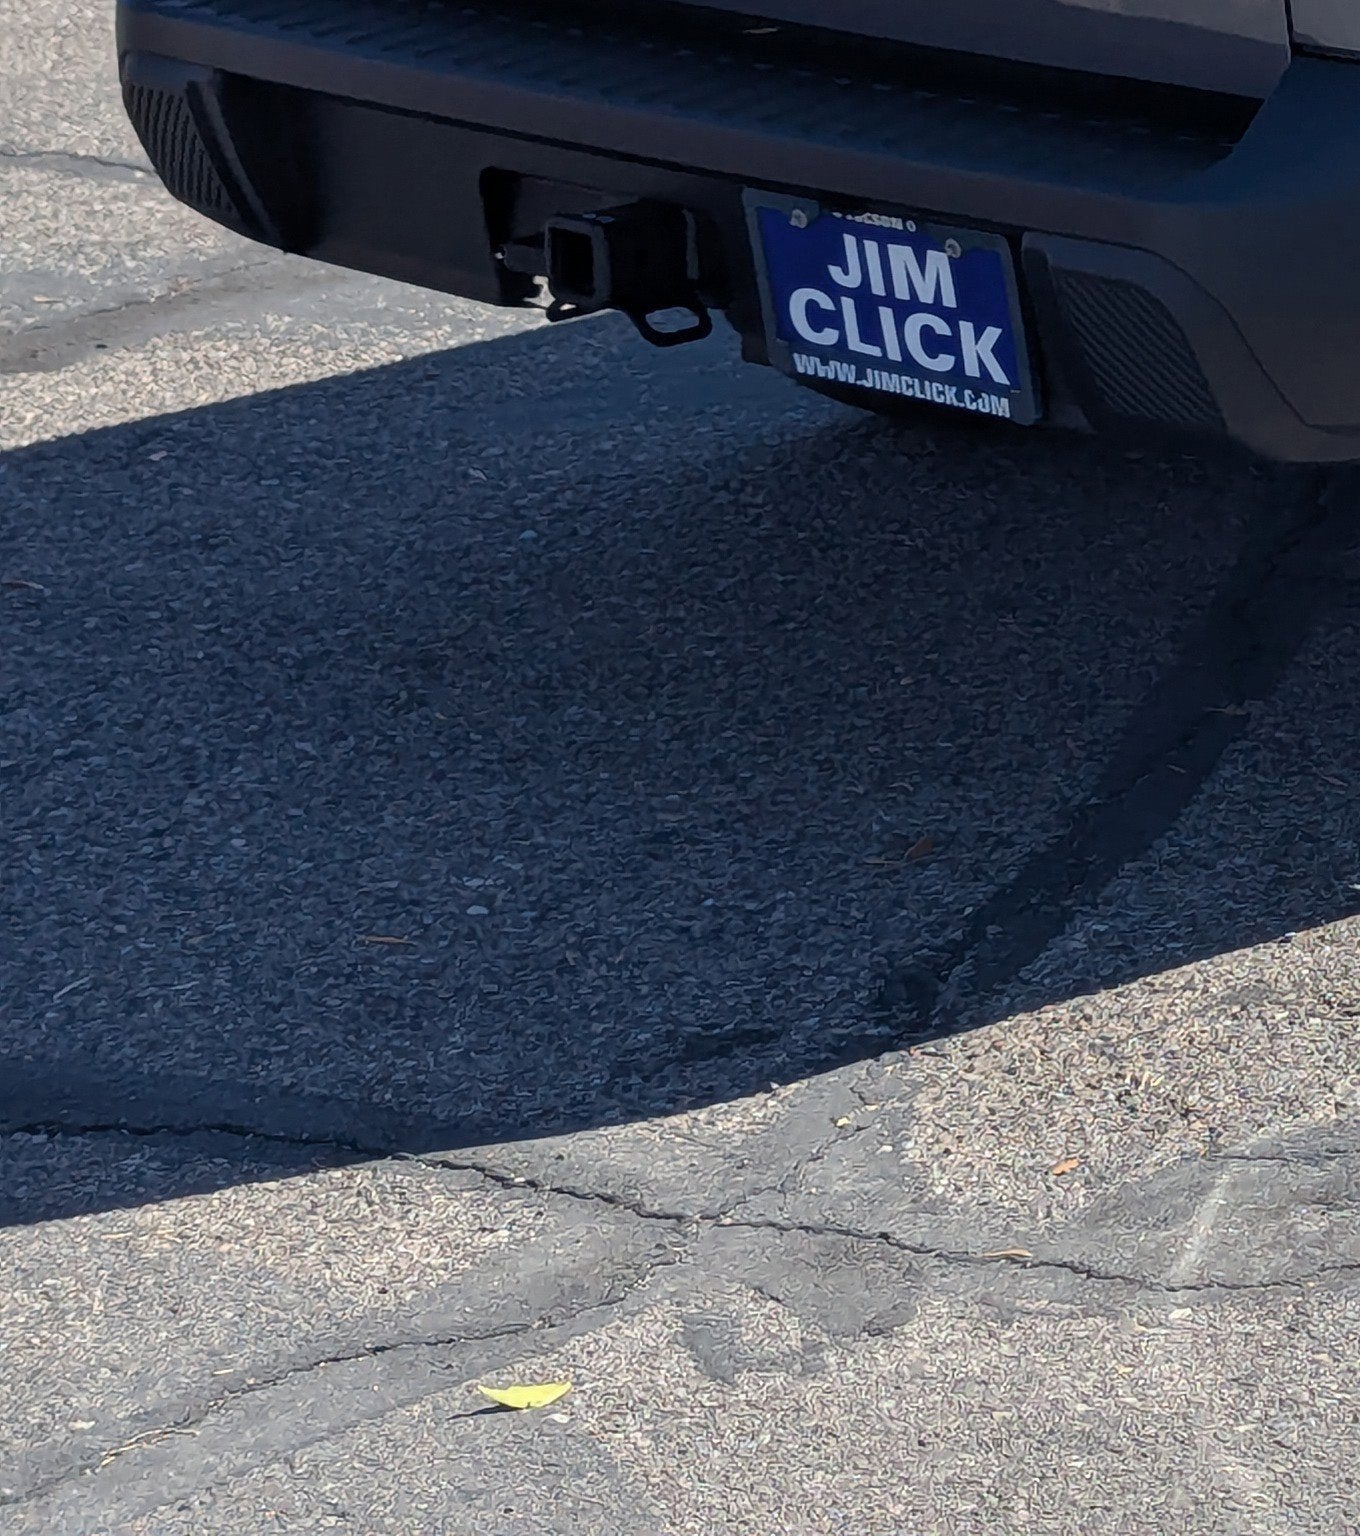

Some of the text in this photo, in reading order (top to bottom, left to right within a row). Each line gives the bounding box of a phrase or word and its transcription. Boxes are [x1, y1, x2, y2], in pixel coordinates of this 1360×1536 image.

[827, 233, 957, 308] JIM
[788, 287, 1011, 385] CLICK
[793, 352, 1011, 419] WWW.JIMCLICK.COM
